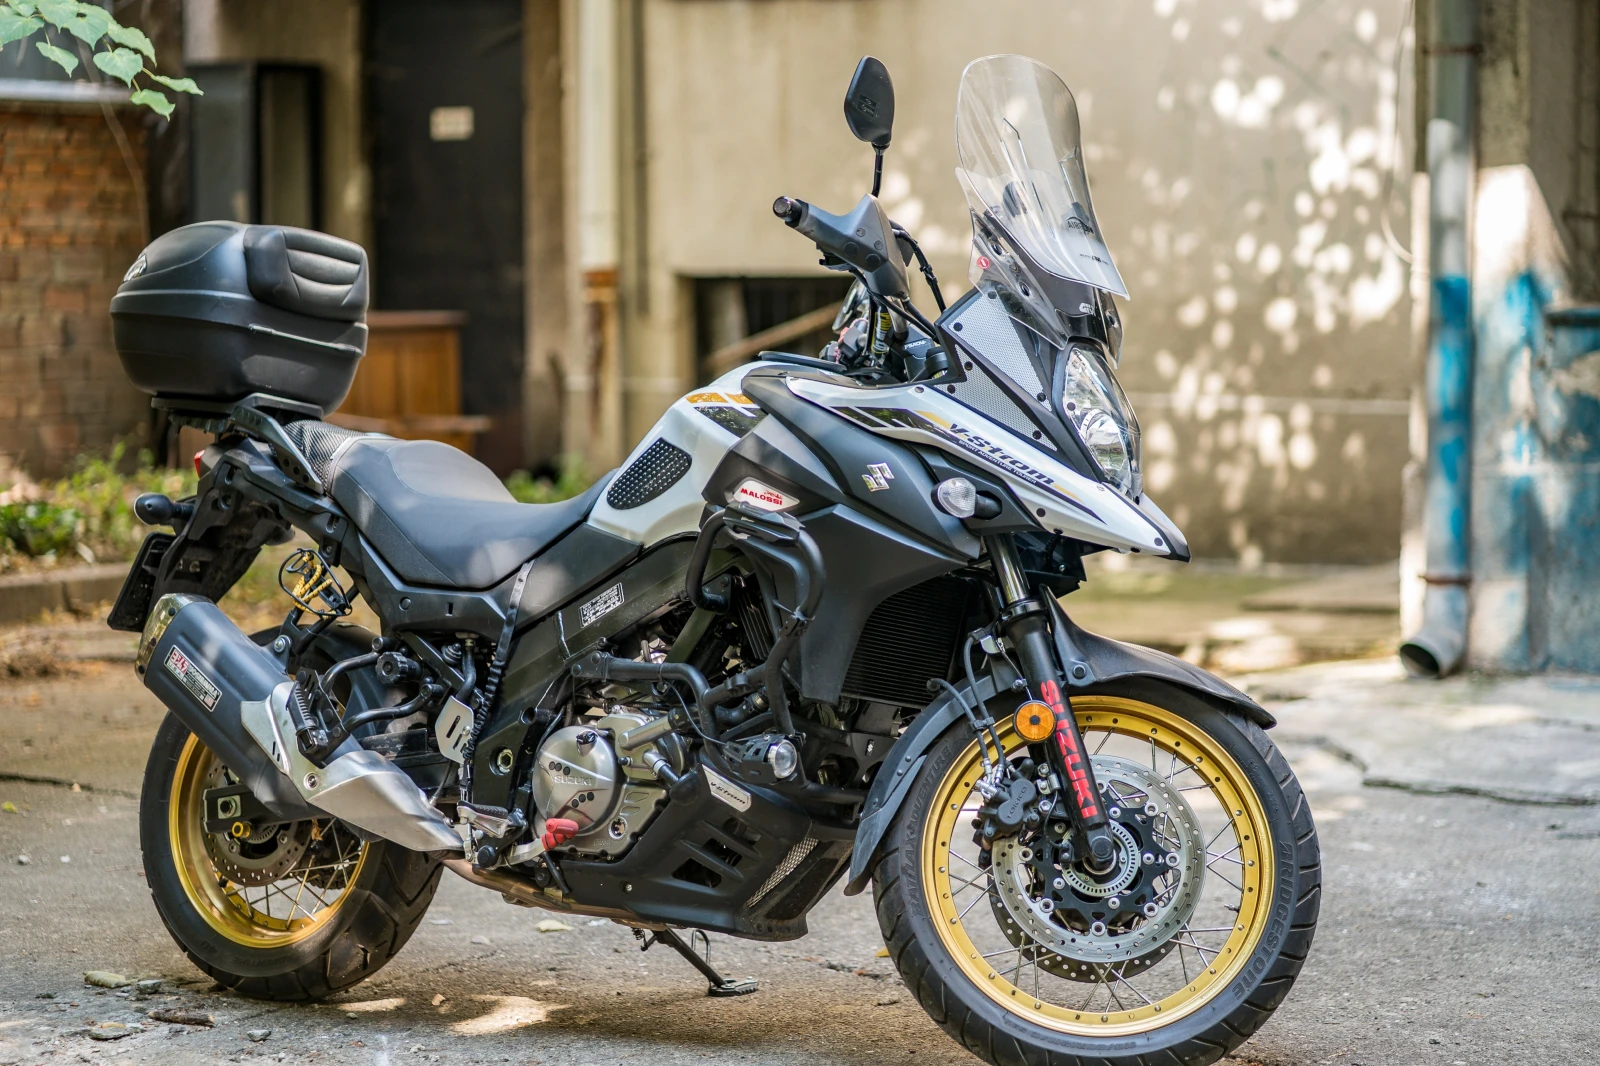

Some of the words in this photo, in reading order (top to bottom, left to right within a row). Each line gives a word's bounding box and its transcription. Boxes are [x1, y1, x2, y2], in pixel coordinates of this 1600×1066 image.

[949, 423, 1055, 485] V-Strom
[959, 439, 978, 453] SPORT
[978, 448, 1013, 471] ADVENTURE
[1012, 466, 1037, 484] TOURER
[740, 487, 783, 505] MALOSSI
[1040, 679, 1099, 819] SUZUKI
[554, 775, 593, 786] SUZUKI
[907, 745, 953, 833] ADVENTURE
[1005, 786, 1027, 819] TOKICO
[1232, 840, 1294, 1001] BRIDGESTONE
